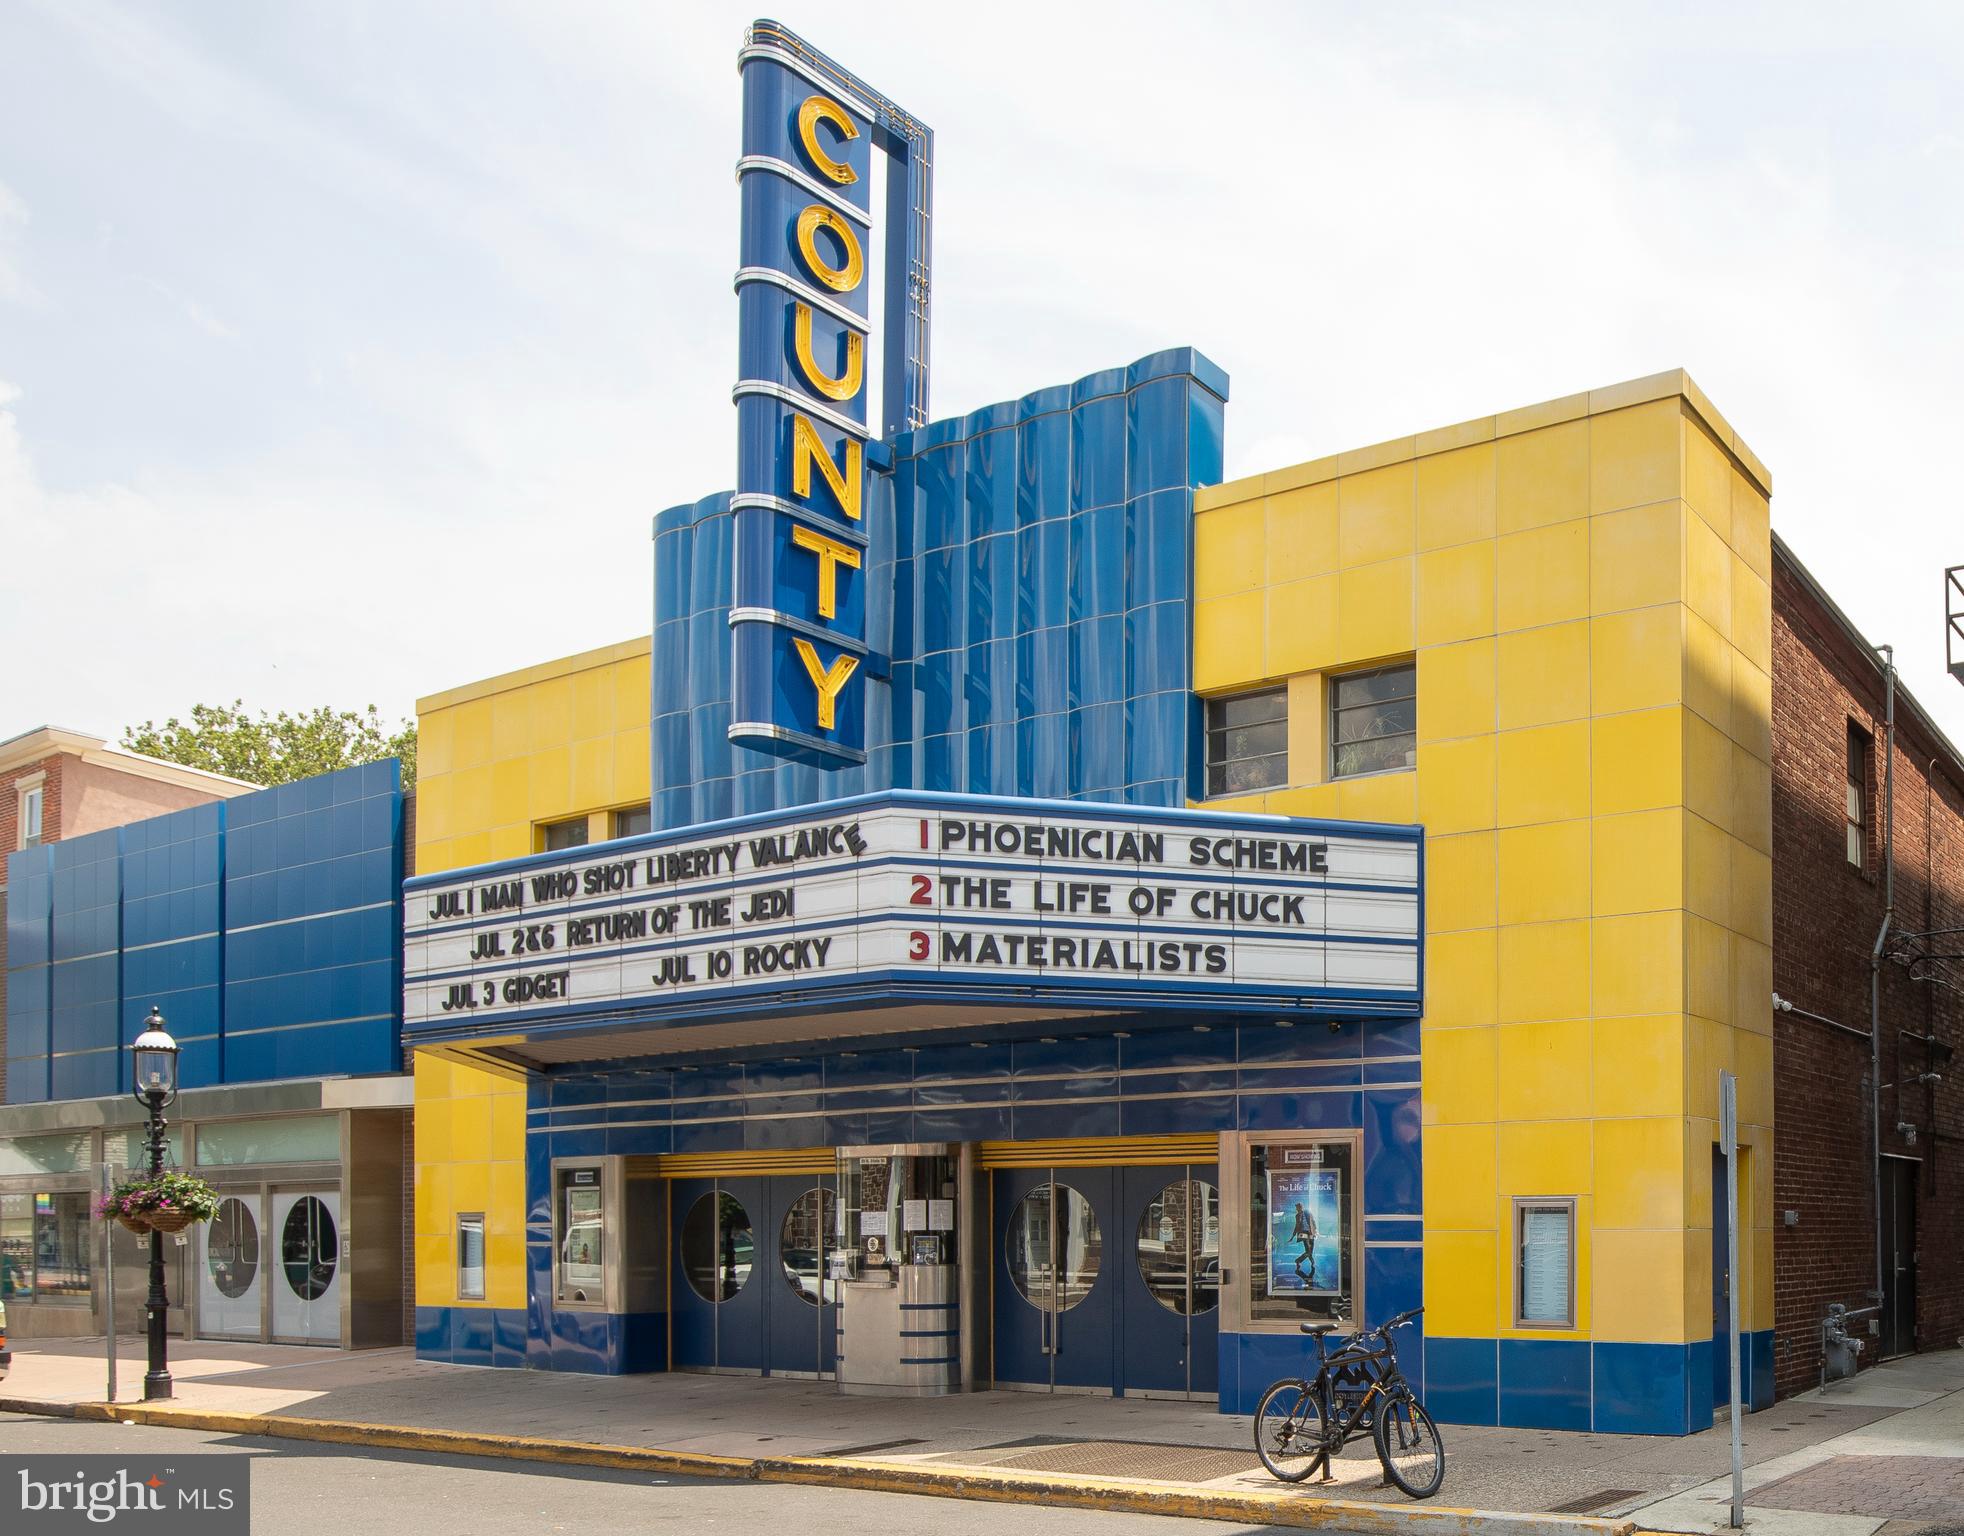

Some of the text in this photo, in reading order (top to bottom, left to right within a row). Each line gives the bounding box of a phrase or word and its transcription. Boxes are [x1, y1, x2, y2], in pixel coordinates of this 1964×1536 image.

[793, 95, 863, 730] COUNTY
[430, 892, 464, 920] JUL
[481, 880, 523, 913] MAN
[532, 871, 577, 903] WHO
[583, 860, 635, 895] SHOT
[646, 842, 740, 885] LIBERTY
[749, 822, 867, 868] VALANCE
[920, 819, 1329, 874] 1 PHOENICIAN SCHEME
[470, 888, 794, 960] JUL 2&6 RETURN OF THE JEDI
[911, 875, 1305, 924] 2 THE LIFE OF CHUCK
[652, 938, 832, 986] JUL 10 ROCKY
[910, 931, 1227, 973] 3 MATERIALISTS
[442, 970, 569, 1011] JUL 3 GIDGET
[1290, 1183, 1303, 1191] Life
